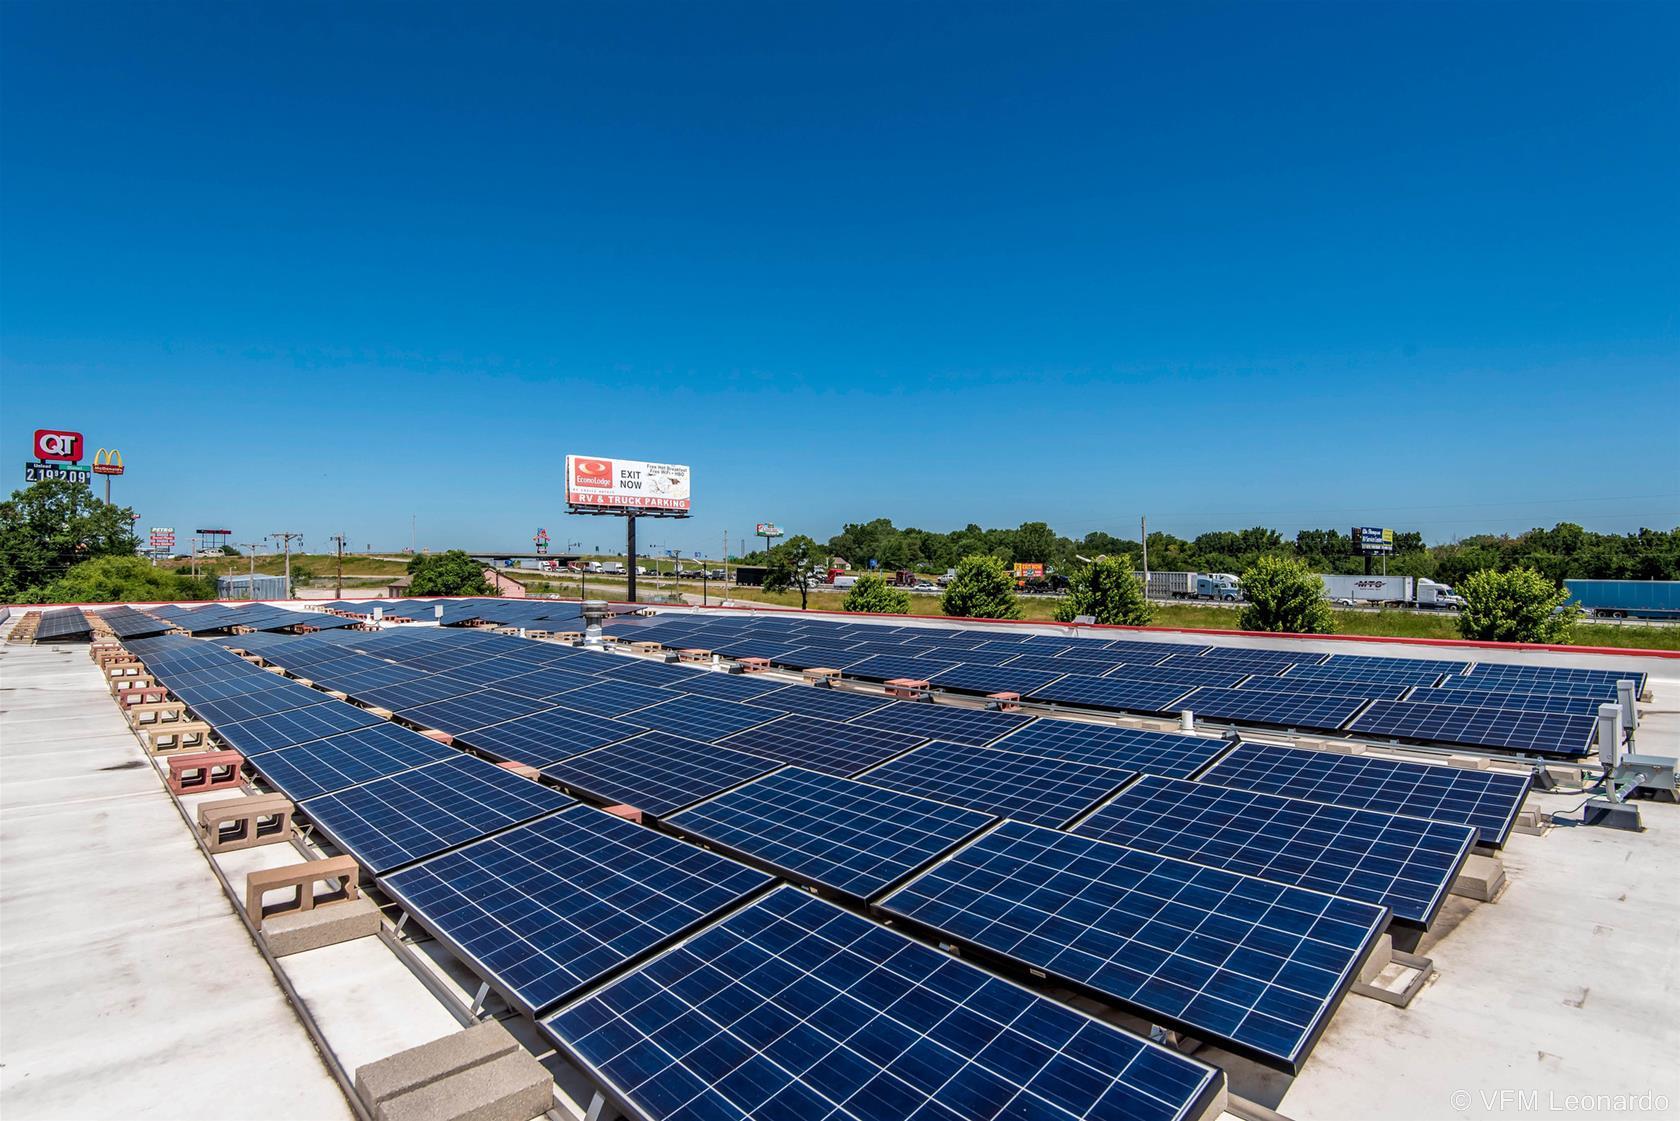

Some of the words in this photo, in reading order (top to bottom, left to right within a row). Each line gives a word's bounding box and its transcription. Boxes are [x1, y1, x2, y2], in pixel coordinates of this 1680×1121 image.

[39, 434, 75, 456] QT
[621, 470, 641, 479] EXIT
[620, 481, 642, 489] NOW
[579, 494, 593, 503] RV
[608, 496, 642, 505] TRUCK
[645, 497, 685, 507] PARKING
